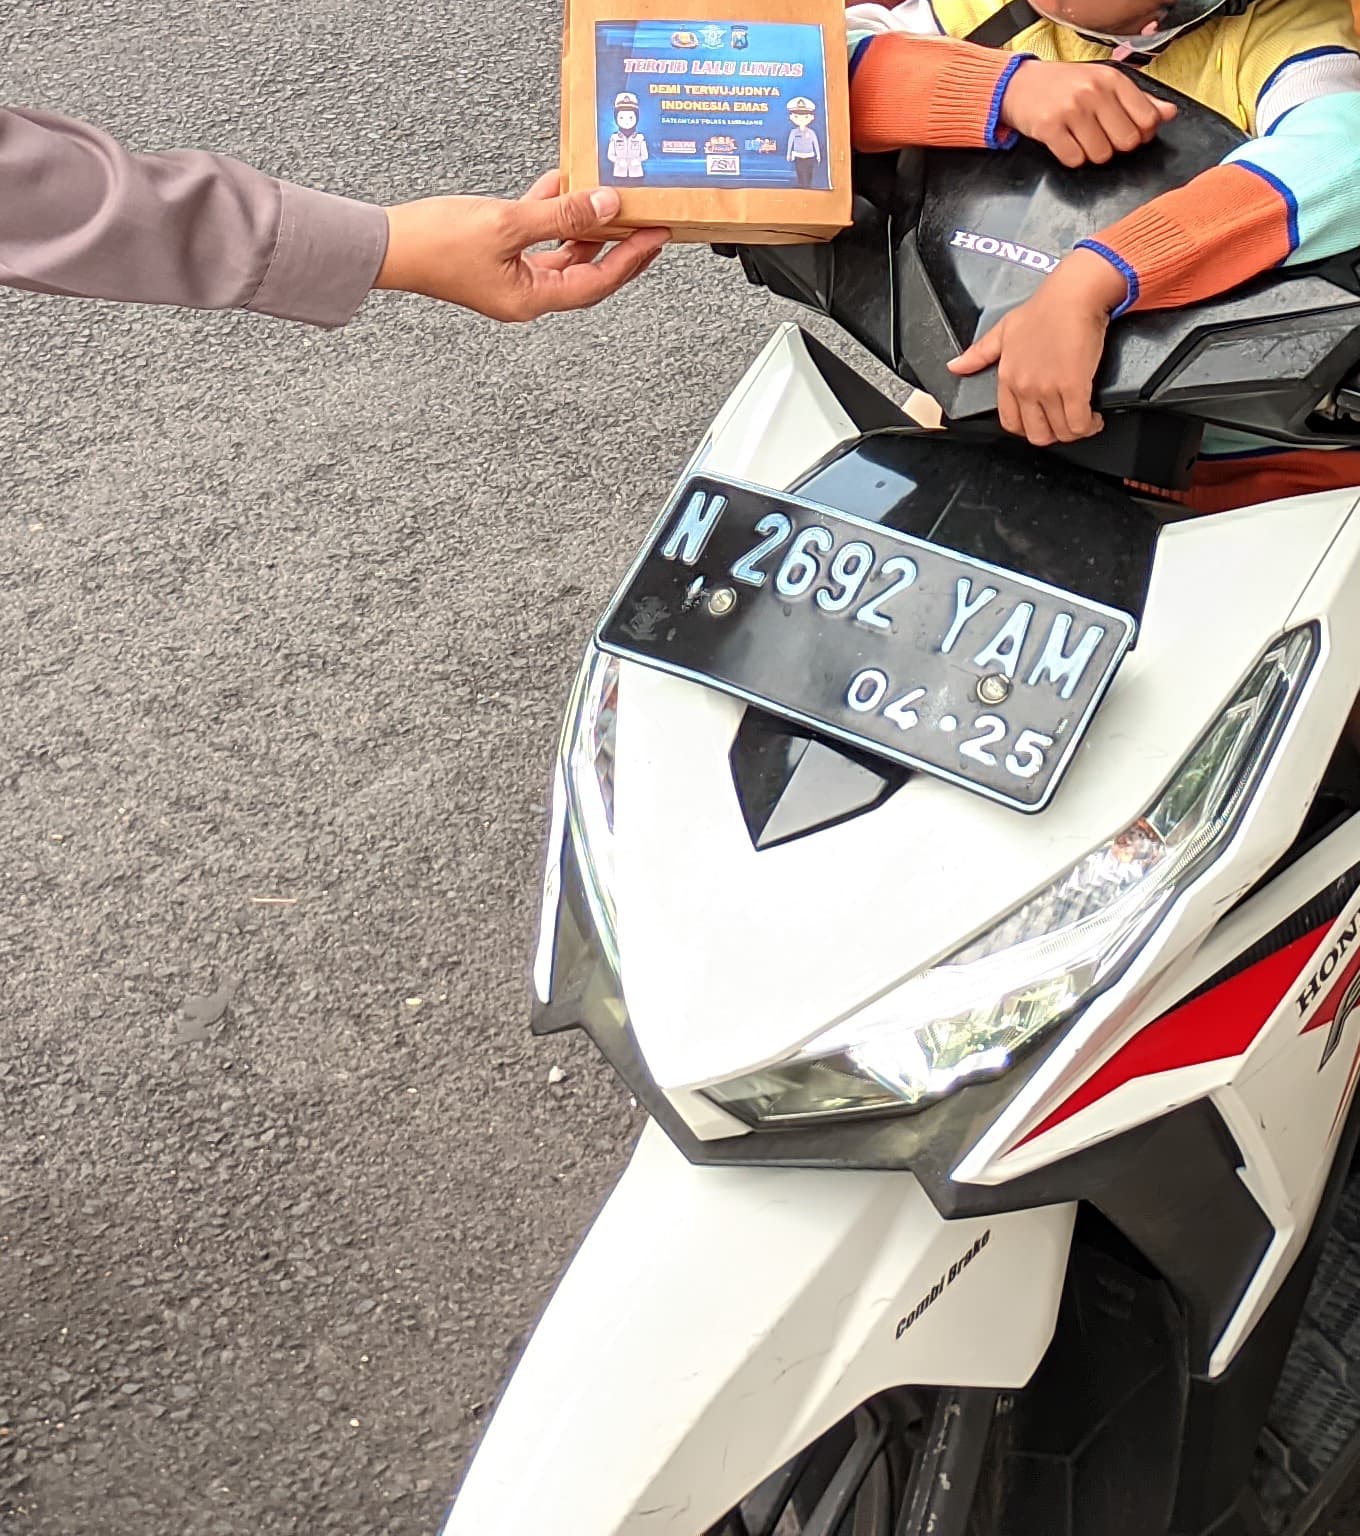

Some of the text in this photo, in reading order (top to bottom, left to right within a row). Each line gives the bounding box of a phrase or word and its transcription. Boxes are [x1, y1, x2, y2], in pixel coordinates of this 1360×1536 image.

[623, 58, 804, 78] TERTIB LALU LINTAS
[649, 84, 781, 97] DEMI TERWUJUDNYA
[661, 100, 769, 113] INDONESIA EMAS
[661, 490, 1106, 701] N 2692 YAM
[895, 1228, 992, 1340] Combi Brake
